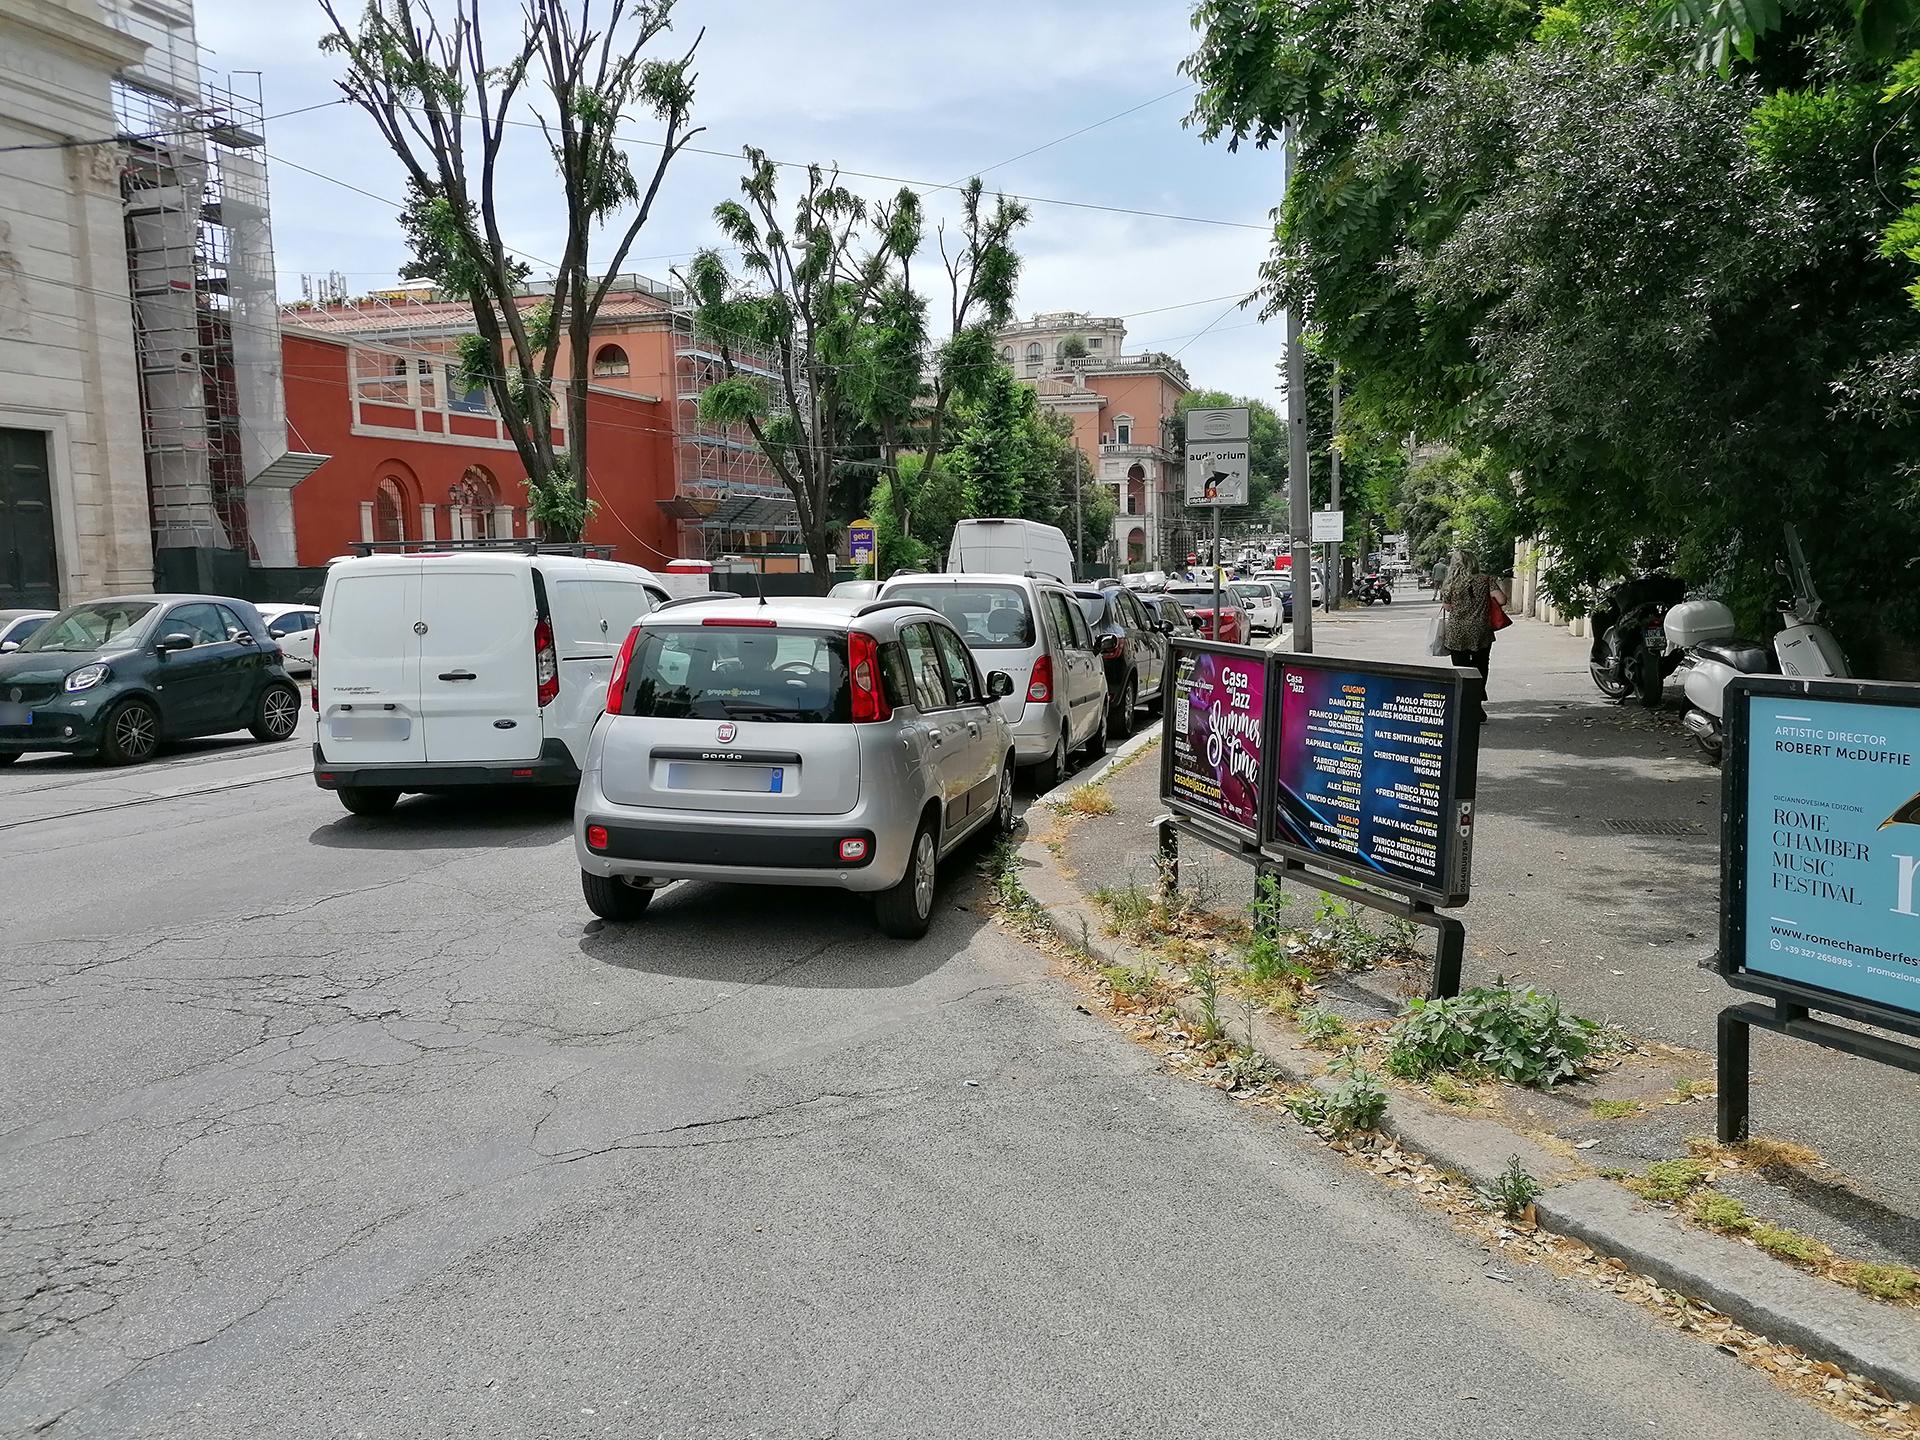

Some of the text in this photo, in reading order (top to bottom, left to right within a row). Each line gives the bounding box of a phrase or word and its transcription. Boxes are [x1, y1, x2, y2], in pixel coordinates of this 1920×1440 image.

[1190, 452, 1245, 460] audorium
[853, 532, 869, 541] getir
[1222, 667, 1248, 688] Casa
[1286, 673, 1302, 683] Casa
[1292, 683, 1304, 693] Jazz
[1342, 685, 1365, 694] GIUGNO
[1231, 687, 1250, 709] Jazz
[1329, 698, 1364, 709] DANILO REA
[1396, 696, 1445, 709] PAOLO FRESU/
[1309, 710, 1364, 724] FRANCO D'ANDREA
[1383, 703, 1445, 718] RITA MARCOTULLI/
[1393, 712, 1444, 726] MORELEMBAUM
[1207, 700, 1261, 766] Summer
[1328, 720, 1363, 732] ORCHESTRA
[1375, 730, 1443, 747] NATE SMITH KINFOLK
[1775, 726, 1887, 746] ARTISTIC DIRECTOR
[1306, 739, 1362, 754] RAPHAEL GUALAZZI
[1776, 741, 1911, 766] ROBERT McDUFFIE
[1313, 756, 1362, 771] FABRIZIO BOSSO/
[1374, 750, 1441, 769] CHRISTONE KINGFISH
[1316, 764, 1361, 778] JAVIER GIROTTO
[1414, 766, 1440, 777] INGRAM
[1174, 774, 1221, 799] casadeljazz.com
[1327, 782, 1360, 795] ALEX BRITTI
[1395, 783, 1439, 799] ENRICO RAVA
[1306, 793, 1360, 812] VINICIO CAPOSSELA
[1376, 788, 1439, 807] +FRED HERSCH TRIO
[1774, 795, 1864, 813] DICIANNOVESIMA EDIZIONE
[1338, 814, 1360, 826] LUGLIO
[1373, 815, 1437, 837] MAKAYA MCCRAVEN
[1774, 809, 1829, 833] ROME
[1310, 821, 1359, 839] MIKE STERN BAND
[1315, 836, 1358, 854] JOHN SCOFIELD
[1373, 836, 1436, 859] ENRICO PIERANUNZI
[1773, 830, 1870, 862] CHAMBER
[1374, 844, 1436, 867] /ANTONELLO SALIS
[1773, 851, 1834, 877] MUSIC
[1773, 872, 1862, 905] FESTIVAL
[1784, 945, 1799, 955] +39
[1801, 948, 1815, 958] 327
[1817, 952, 1853, 968] 2658985
